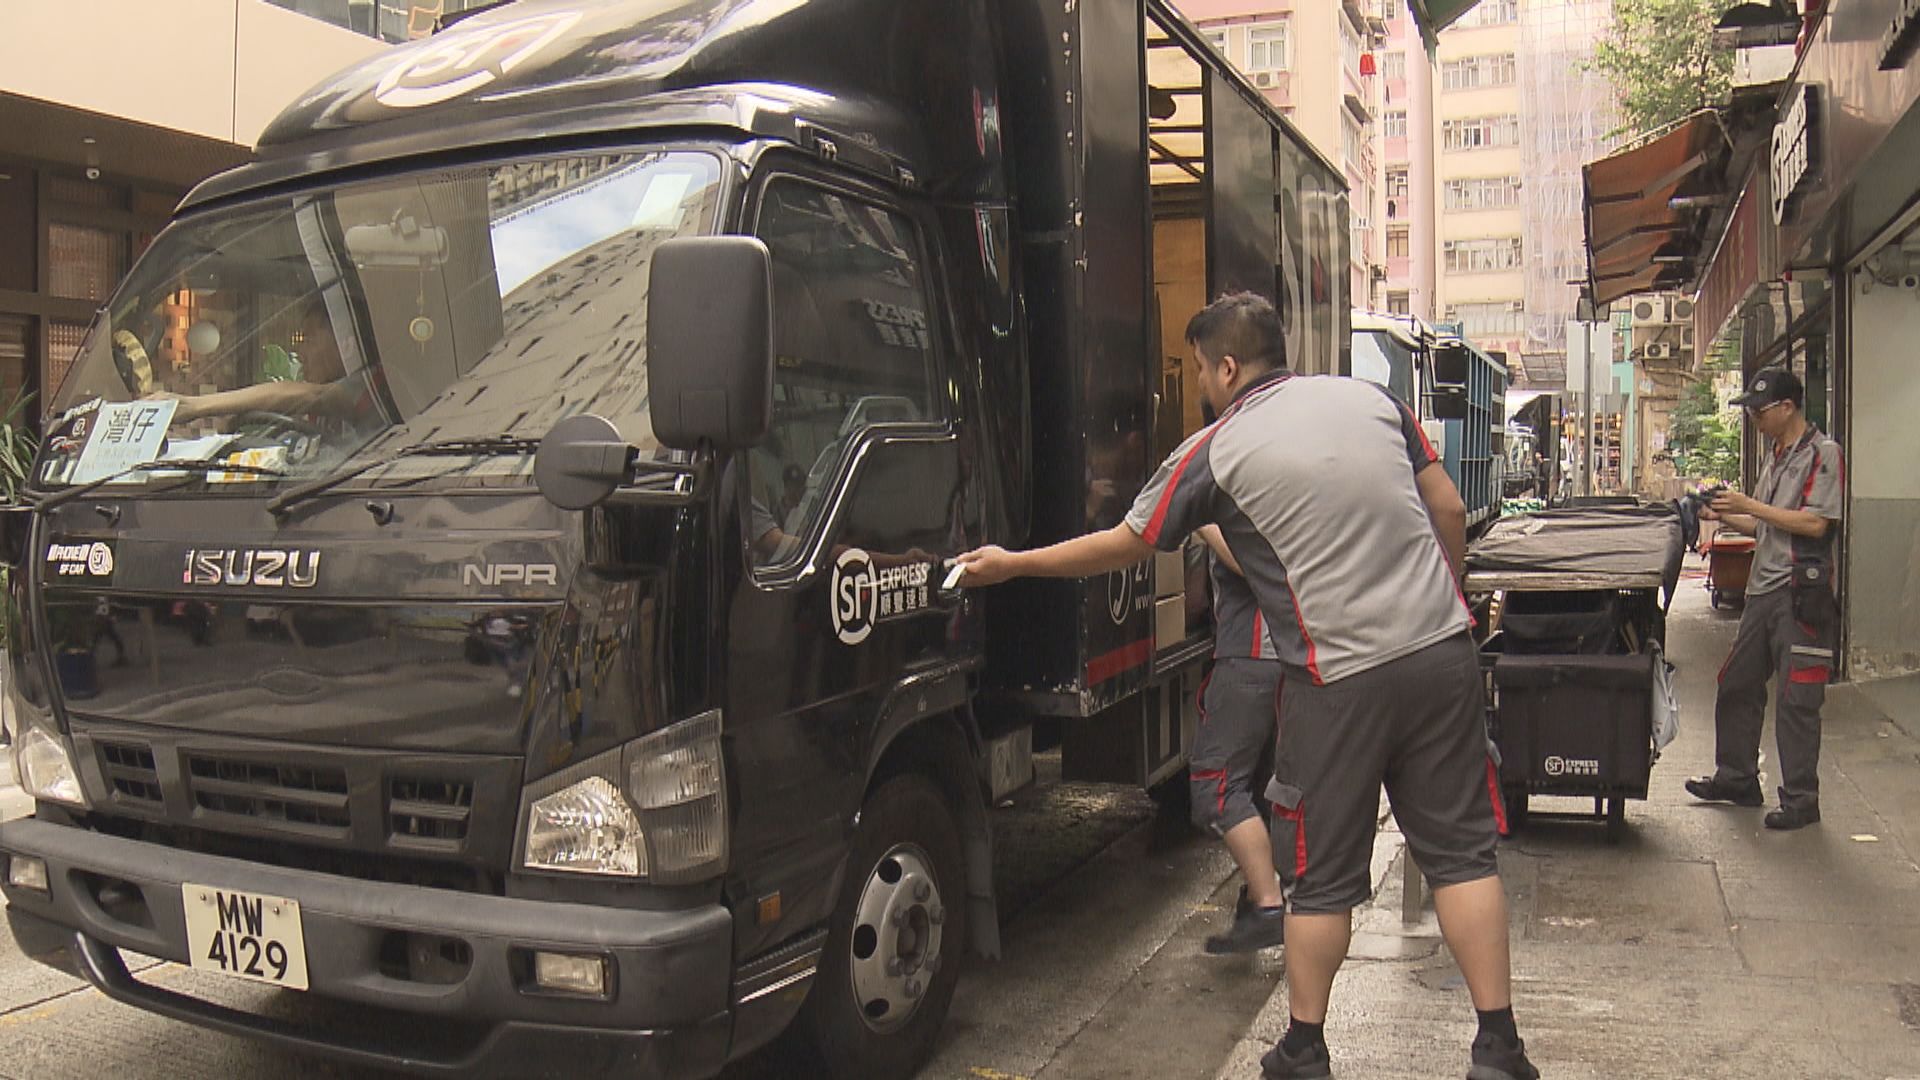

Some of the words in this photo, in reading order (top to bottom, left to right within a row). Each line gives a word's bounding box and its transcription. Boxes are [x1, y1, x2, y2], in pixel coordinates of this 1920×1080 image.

[101, 407, 159, 443] 灣仔
[183, 549, 321, 588] ISUZU
[463, 563, 557, 586] NPR
[880, 561, 929, 592] EXPRESS
[216, 891, 263, 937] MW
[207, 930, 288, 981] 4129
